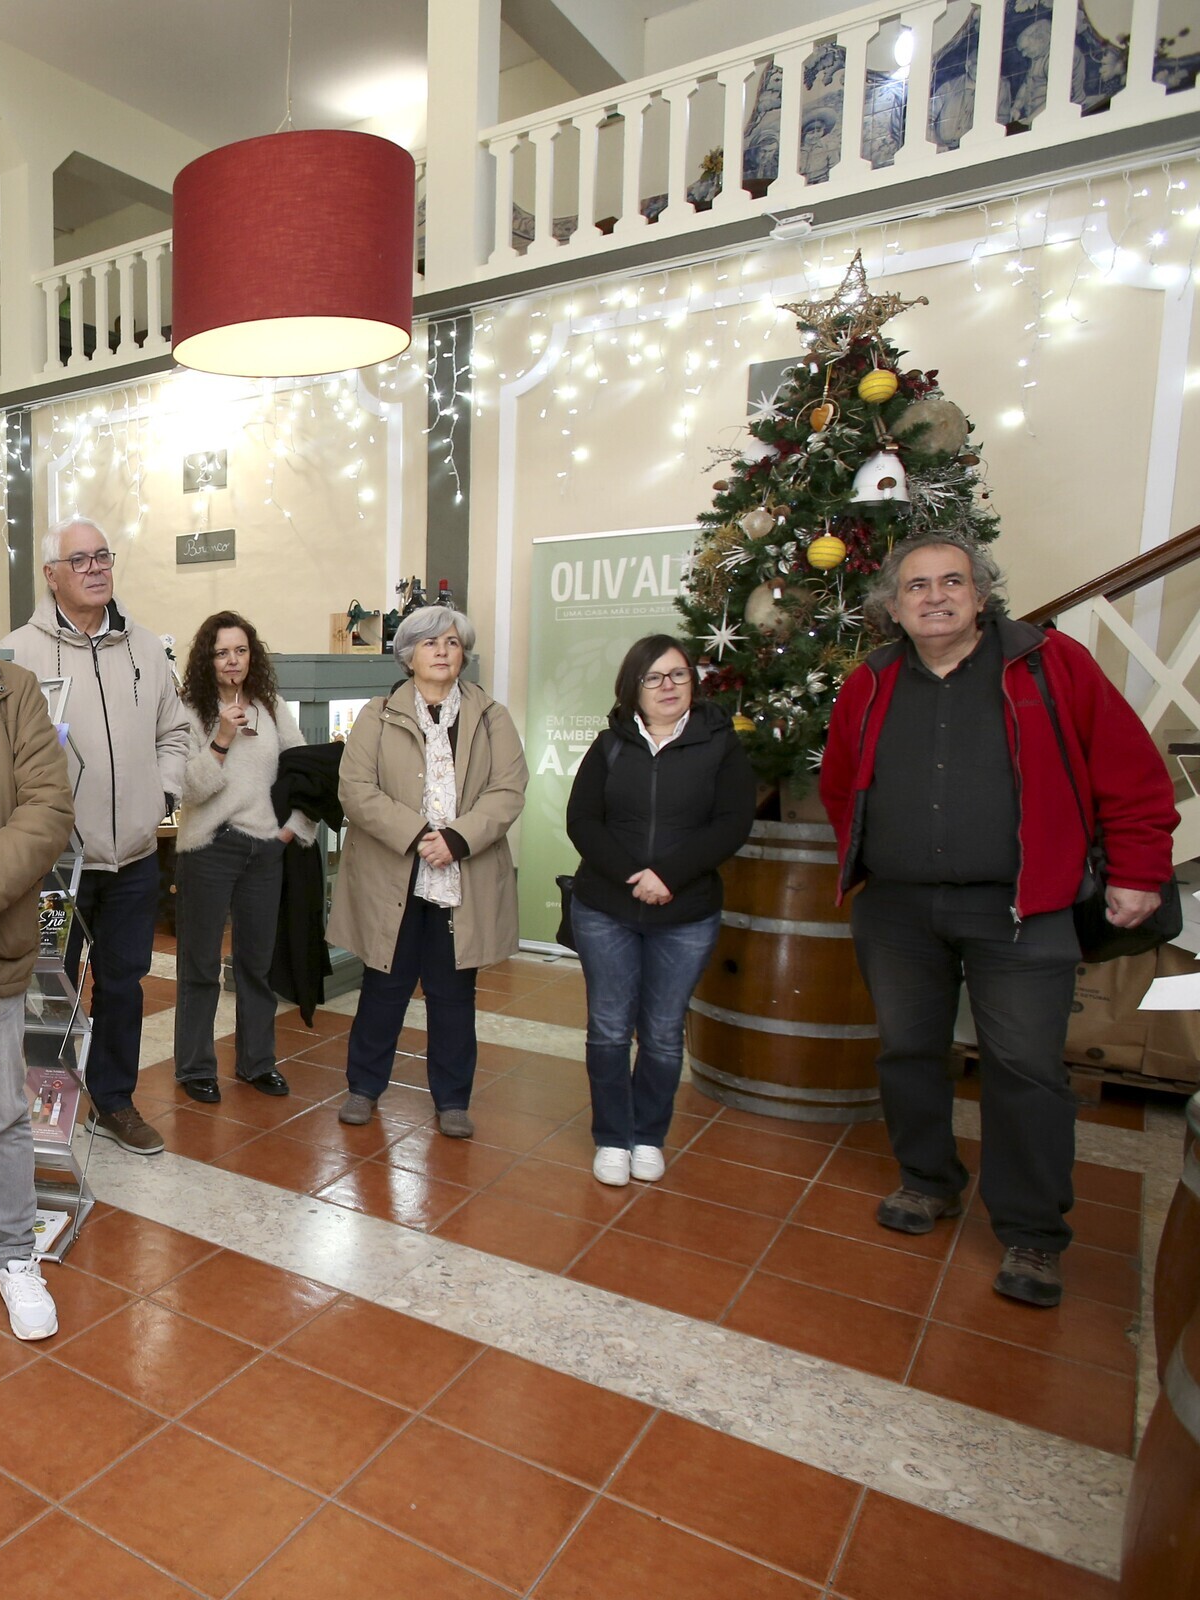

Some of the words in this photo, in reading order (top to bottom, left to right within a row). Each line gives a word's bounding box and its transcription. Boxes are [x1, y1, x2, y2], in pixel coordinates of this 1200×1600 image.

[563, 609, 582, 618] UMA
[585, 608, 609, 617] CASA
[633, 606, 647, 615] DO
[546, 715, 564, 727] EM
[570, 715, 609, 727] TERRA
